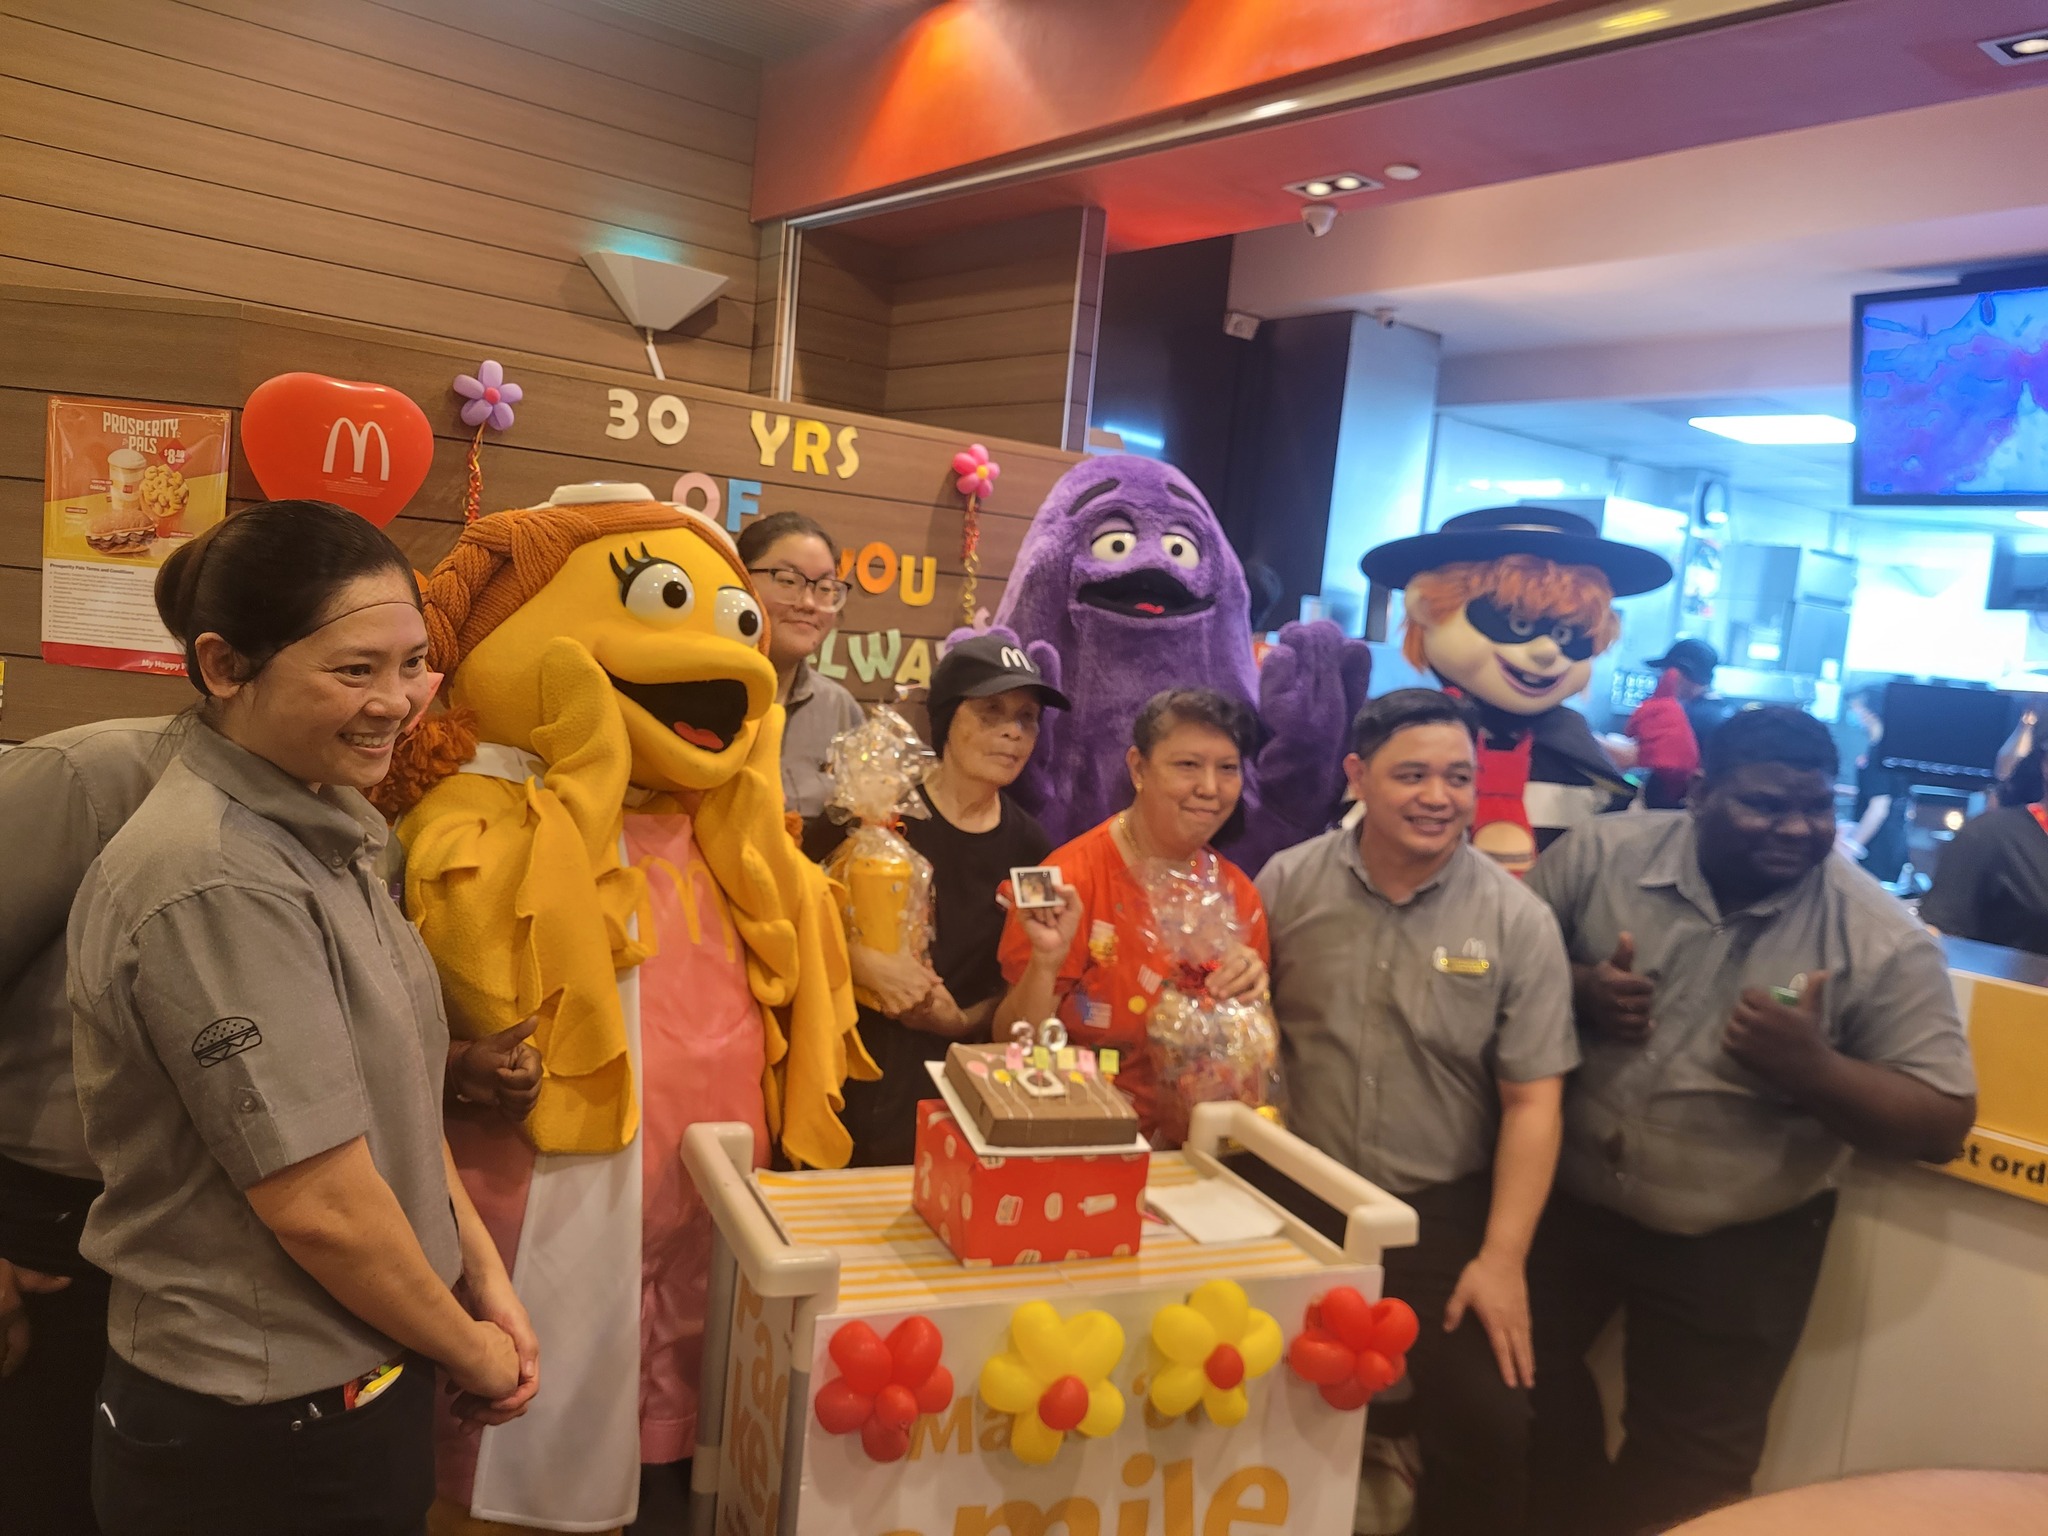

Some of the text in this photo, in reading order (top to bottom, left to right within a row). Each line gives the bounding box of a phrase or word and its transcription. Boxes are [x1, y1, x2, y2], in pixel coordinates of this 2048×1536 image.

[102, 411, 179, 438] PROSPERITY
[128, 437, 158, 455] PALS
[604, 387, 861, 479] 30 YRS
[672, 471, 762, 533] OF
[141, 659, 154, 668] My
[154, 660, 180, 671] Happy
[807, 628, 947, 689] LWA
